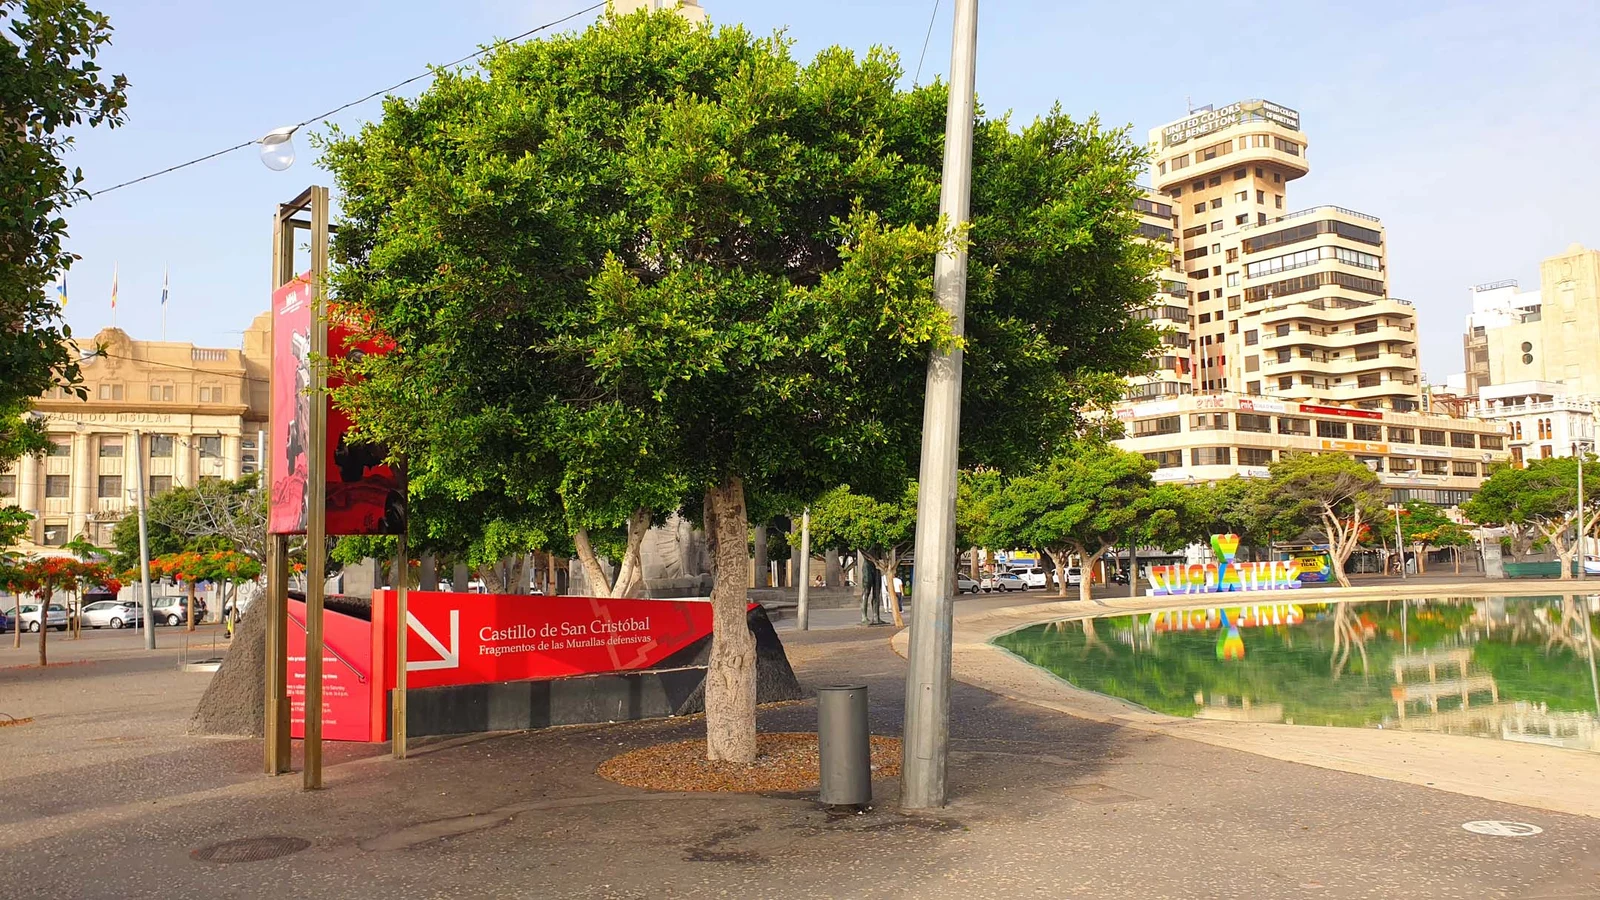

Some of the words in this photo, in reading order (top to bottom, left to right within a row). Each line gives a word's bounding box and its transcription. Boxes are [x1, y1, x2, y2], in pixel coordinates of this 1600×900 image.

[1166, 119, 1199, 136] UNITED
[1201, 102, 1241, 123] COLORS
[1171, 132, 1185, 142] OF
[116, 413, 172, 424] INSULAR
[479, 625, 536, 641] Castillo
[540, 623, 558, 637] de
[561, 622, 587, 636] San
[590, 617, 650, 633] Cristóbal
[479, 643, 536, 657] Fragmentos
[538, 640, 550, 650] de
[551, 640, 564, 650] las
[566, 637, 605, 648] Murallas
[606, 634, 652, 646] defensivas
